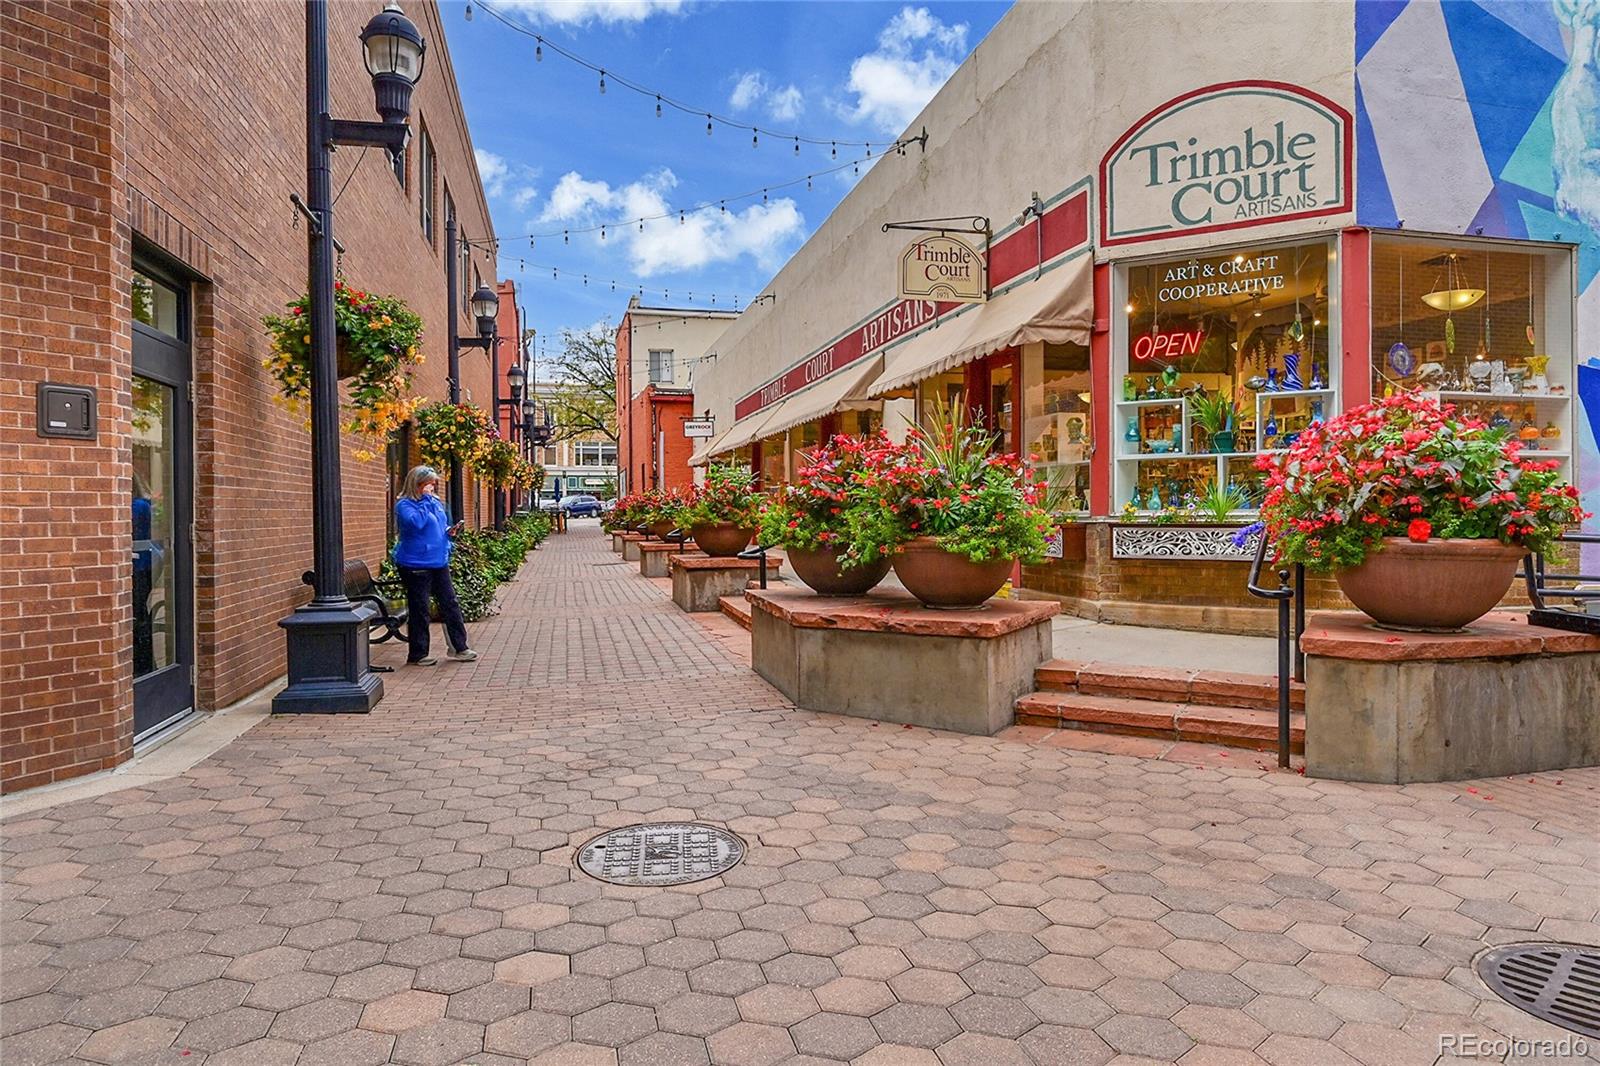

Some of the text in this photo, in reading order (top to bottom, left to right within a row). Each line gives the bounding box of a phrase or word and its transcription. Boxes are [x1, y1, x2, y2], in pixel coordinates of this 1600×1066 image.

[1129, 121, 1316, 187] Trimble
[1171, 162, 1316, 225] Court
[1234, 193, 1317, 219] ARTISANS
[912, 243, 970, 263] Trimble
[925, 264, 970, 281] Court
[1164, 256, 1278, 282] ART & CRAFT
[1158, 275, 1284, 302] COOPERATIVE
[760, 300, 936, 407] TRIMBLE COURT ARTISANS
[1135, 331, 1202, 360] OPEN
